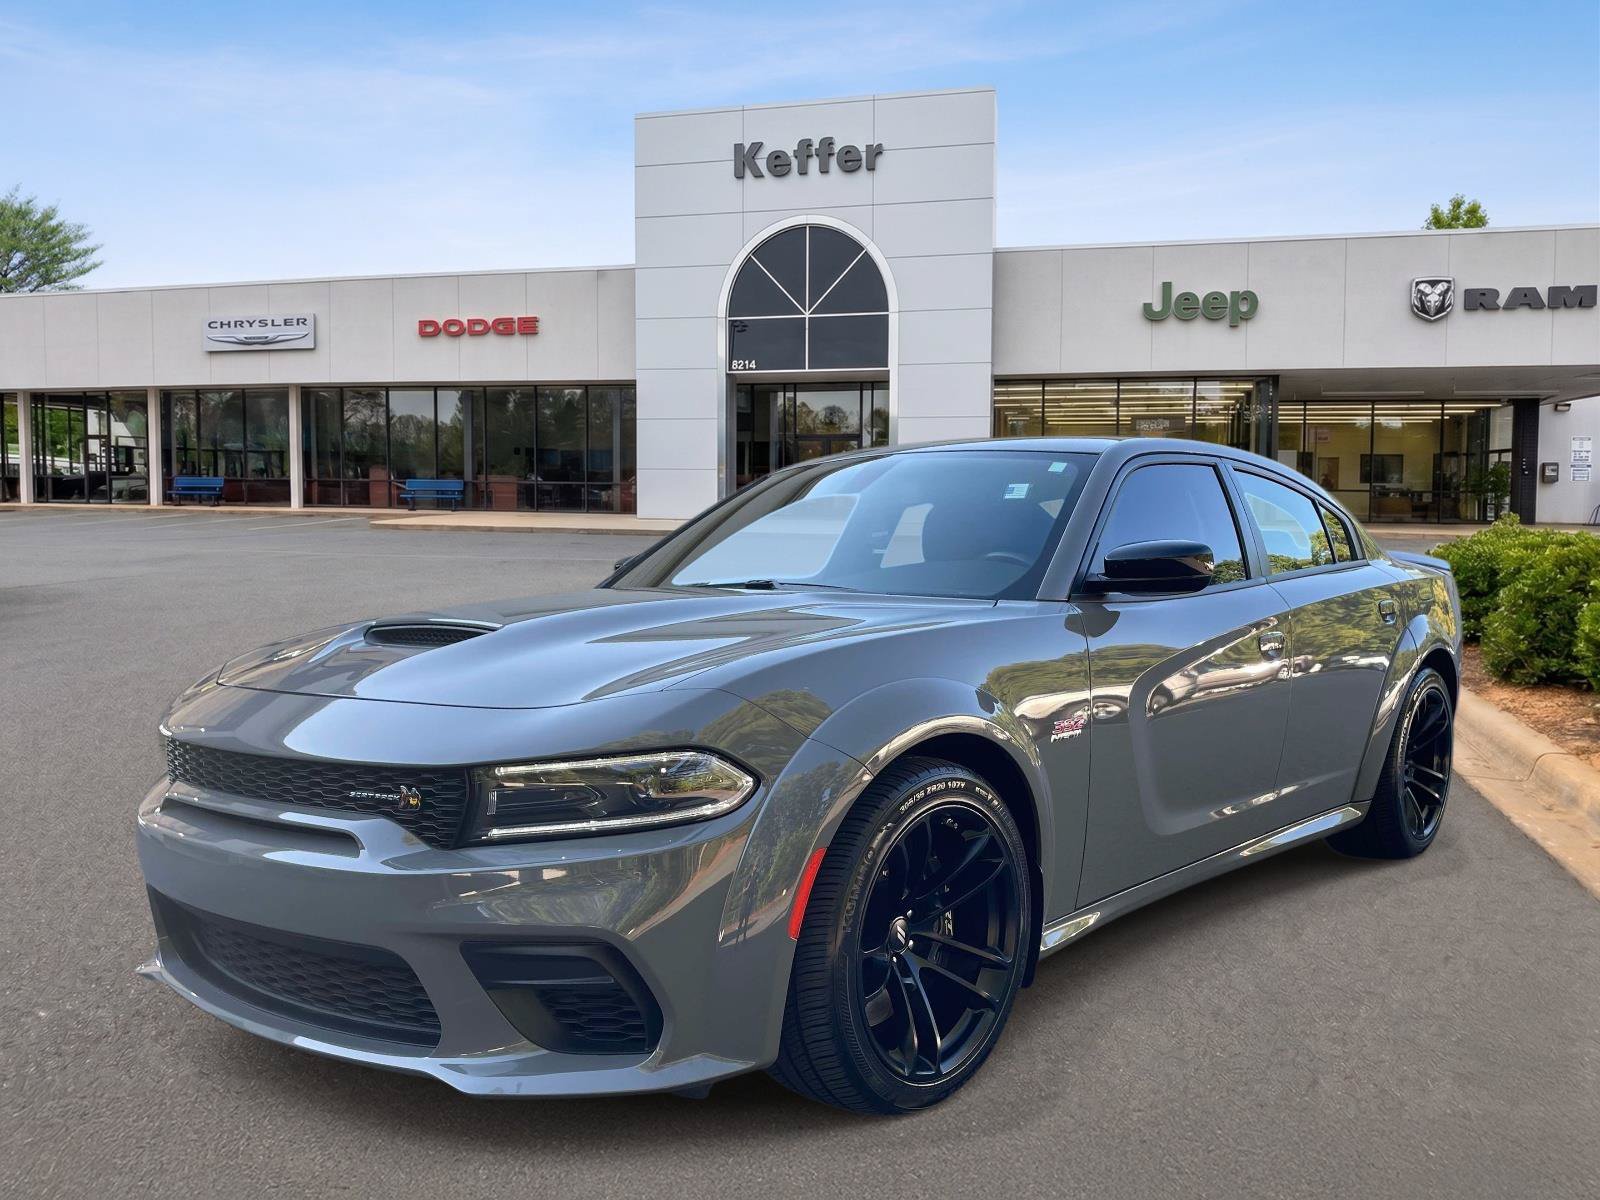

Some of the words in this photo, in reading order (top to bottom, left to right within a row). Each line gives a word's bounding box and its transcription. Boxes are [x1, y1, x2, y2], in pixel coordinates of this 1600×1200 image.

[733, 136, 883, 179] Keffer
[1142, 280, 1261, 329] Jeep
[1463, 284, 1598, 312] RAM
[207, 317, 309, 329] CHRYSLER
[417, 315, 540, 338] DODGE
[732, 360, 756, 371] 8214
